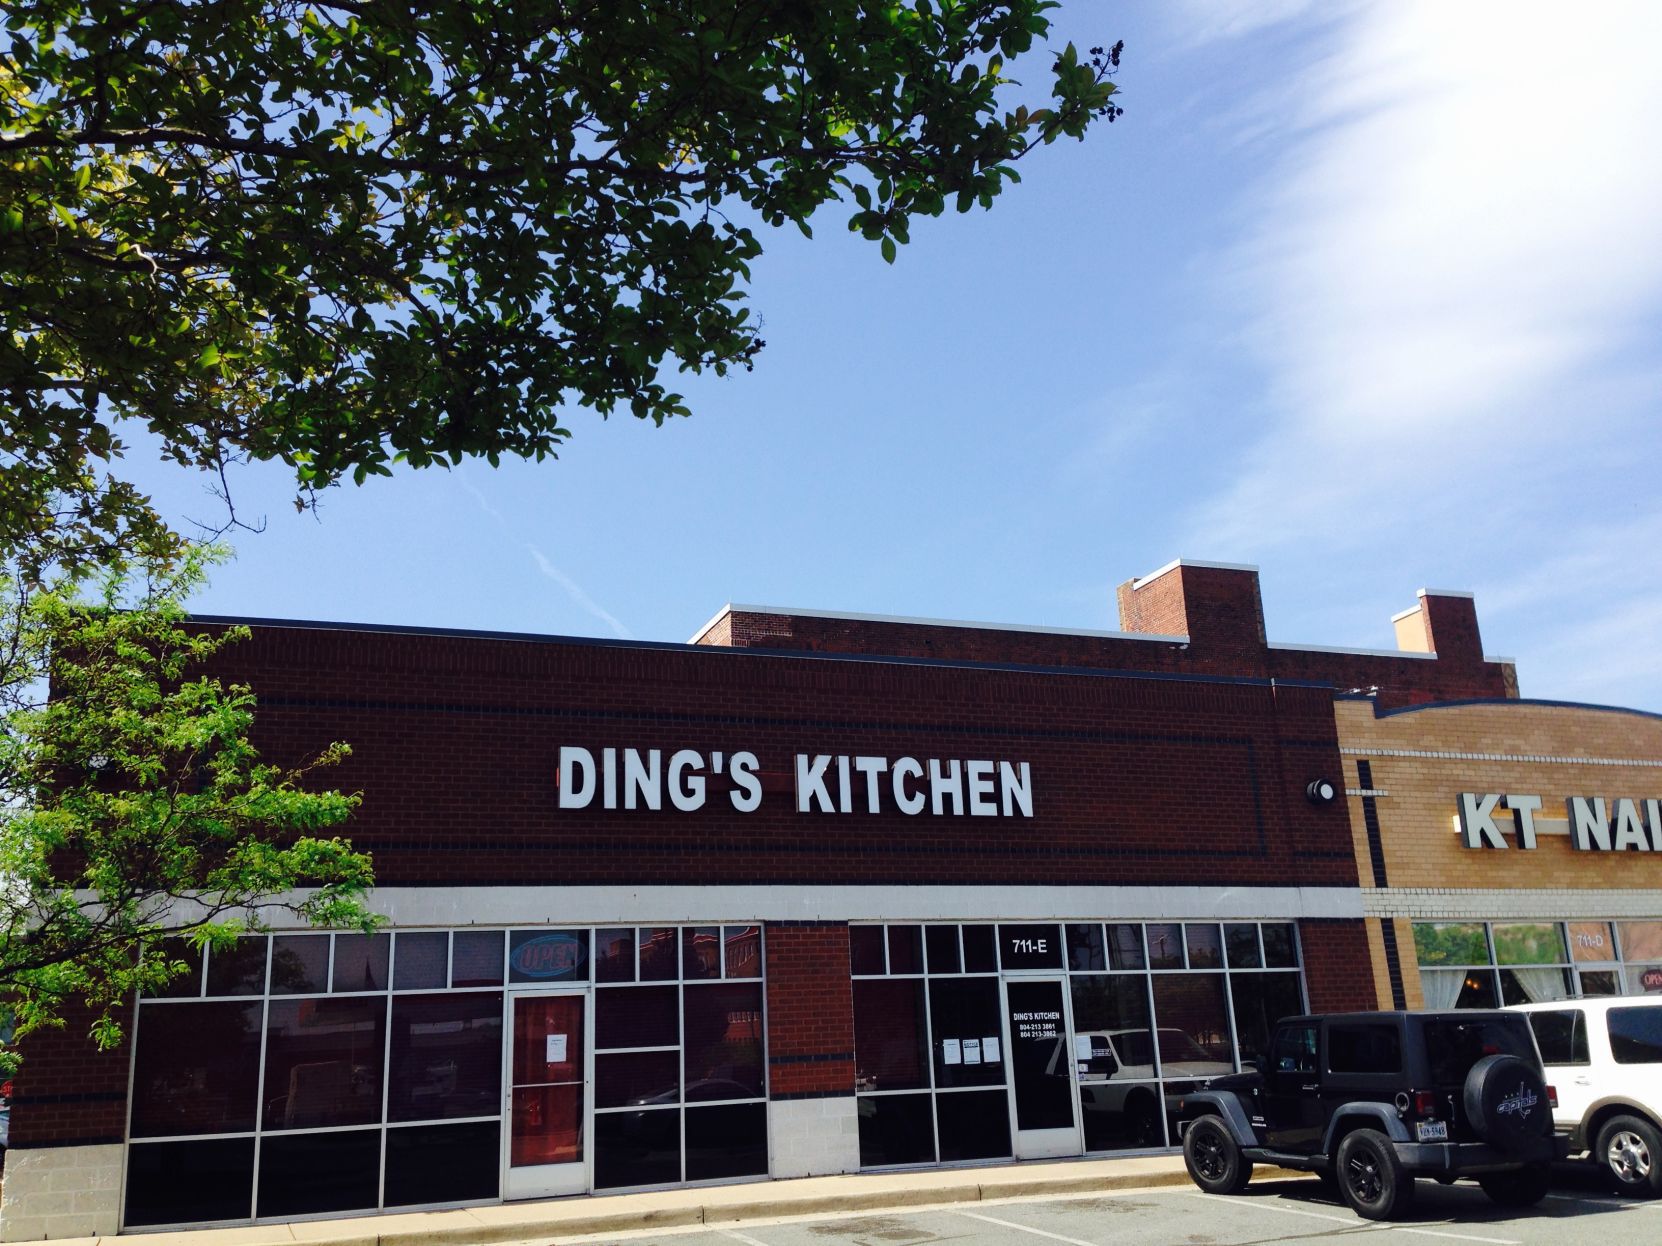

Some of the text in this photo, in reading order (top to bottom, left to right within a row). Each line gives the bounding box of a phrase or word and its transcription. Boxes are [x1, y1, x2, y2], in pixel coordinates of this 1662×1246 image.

[558, 746, 1035, 818] DING'S KITCHEN
[1456, 791, 1542, 850] KT
[1012, 939, 1048, 954] 711-E
[1576, 934, 1604, 948] 711-D
[1013, 1011, 1060, 1021] DING'S KITCHEN
